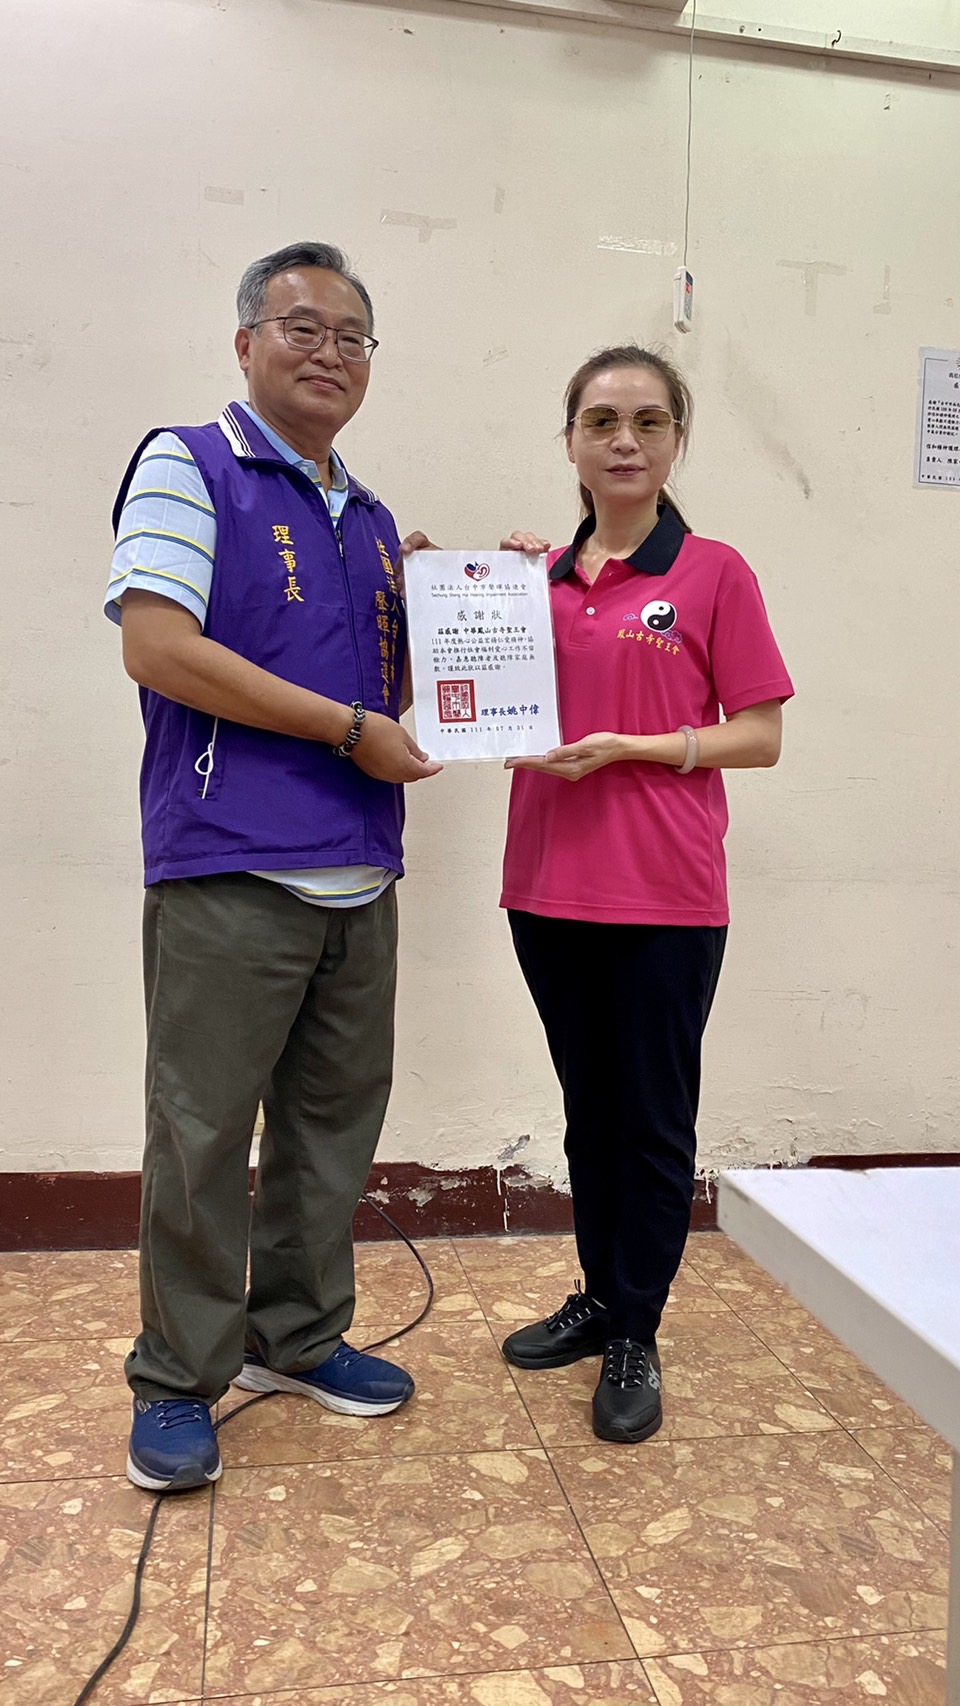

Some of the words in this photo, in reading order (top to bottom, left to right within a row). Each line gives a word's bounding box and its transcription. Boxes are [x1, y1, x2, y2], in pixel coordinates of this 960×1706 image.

[272, 525, 304, 602] 理事長
[457, 610, 502, 621] 感謝狀
[617, 628, 680, 656] 鳳山古寺聖王會
